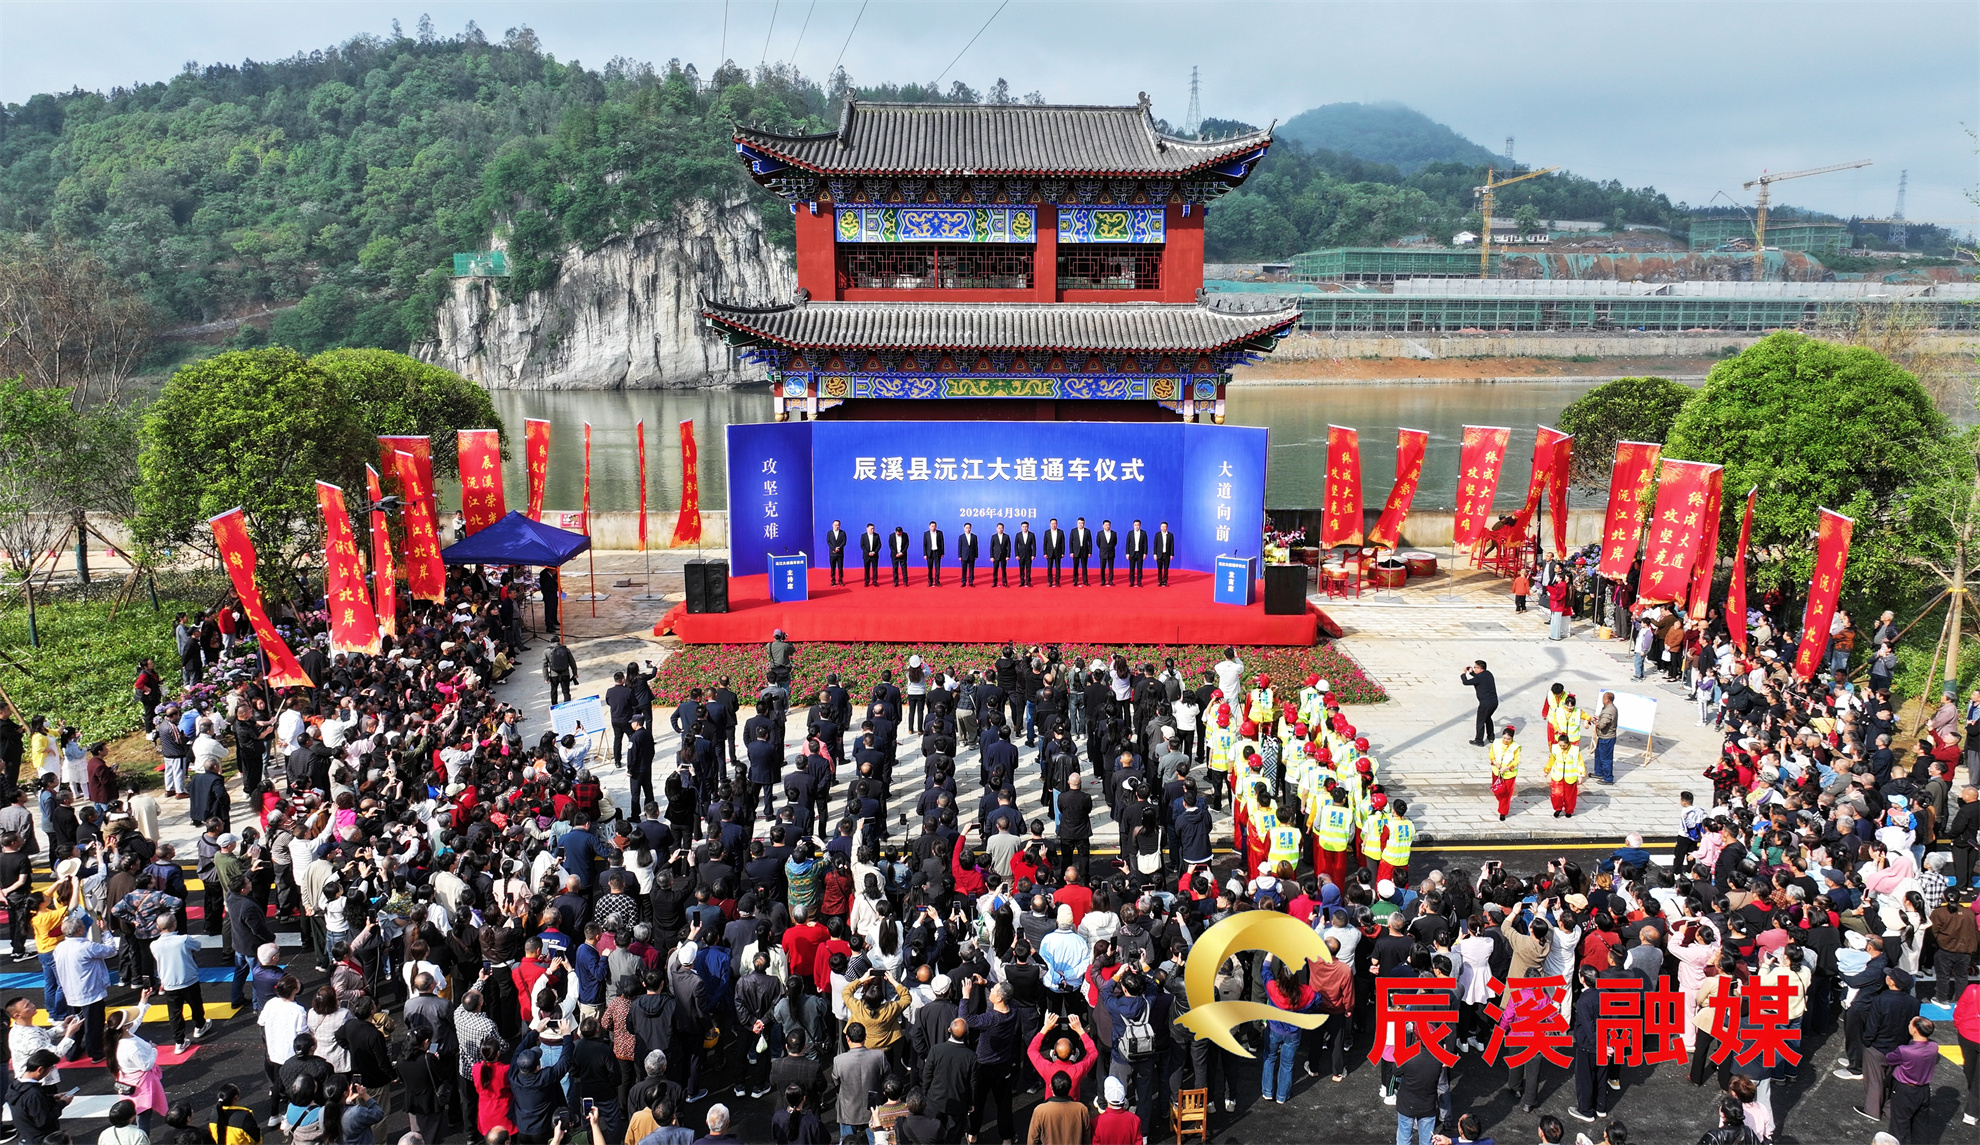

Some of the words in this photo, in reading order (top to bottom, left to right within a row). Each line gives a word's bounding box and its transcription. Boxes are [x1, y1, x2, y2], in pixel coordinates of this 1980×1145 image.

[481, 455, 498, 524] 辰溪荣光
[762, 457, 779, 540] 攻坚克难
[853, 456, 1145, 482] 辰溪县沅江大道通车仪式
[1216, 460, 1233, 542] 大道向前
[1330, 466, 1341, 532] 攻坚克难
[1341, 451, 1355, 514] 终成大道
[1460, 466, 1480, 532] 攻坚克难
[1476, 451, 1500, 516] 终成大道
[959, 507, 1038, 519] 2026年4月30日
[1609, 488, 1631, 562] 沅江北岸
[1649, 508, 1680, 585] 攻坚克难
[1671, 490, 1705, 569] 终成大道
[1799, 573, 1830, 669] 沅江北岸
